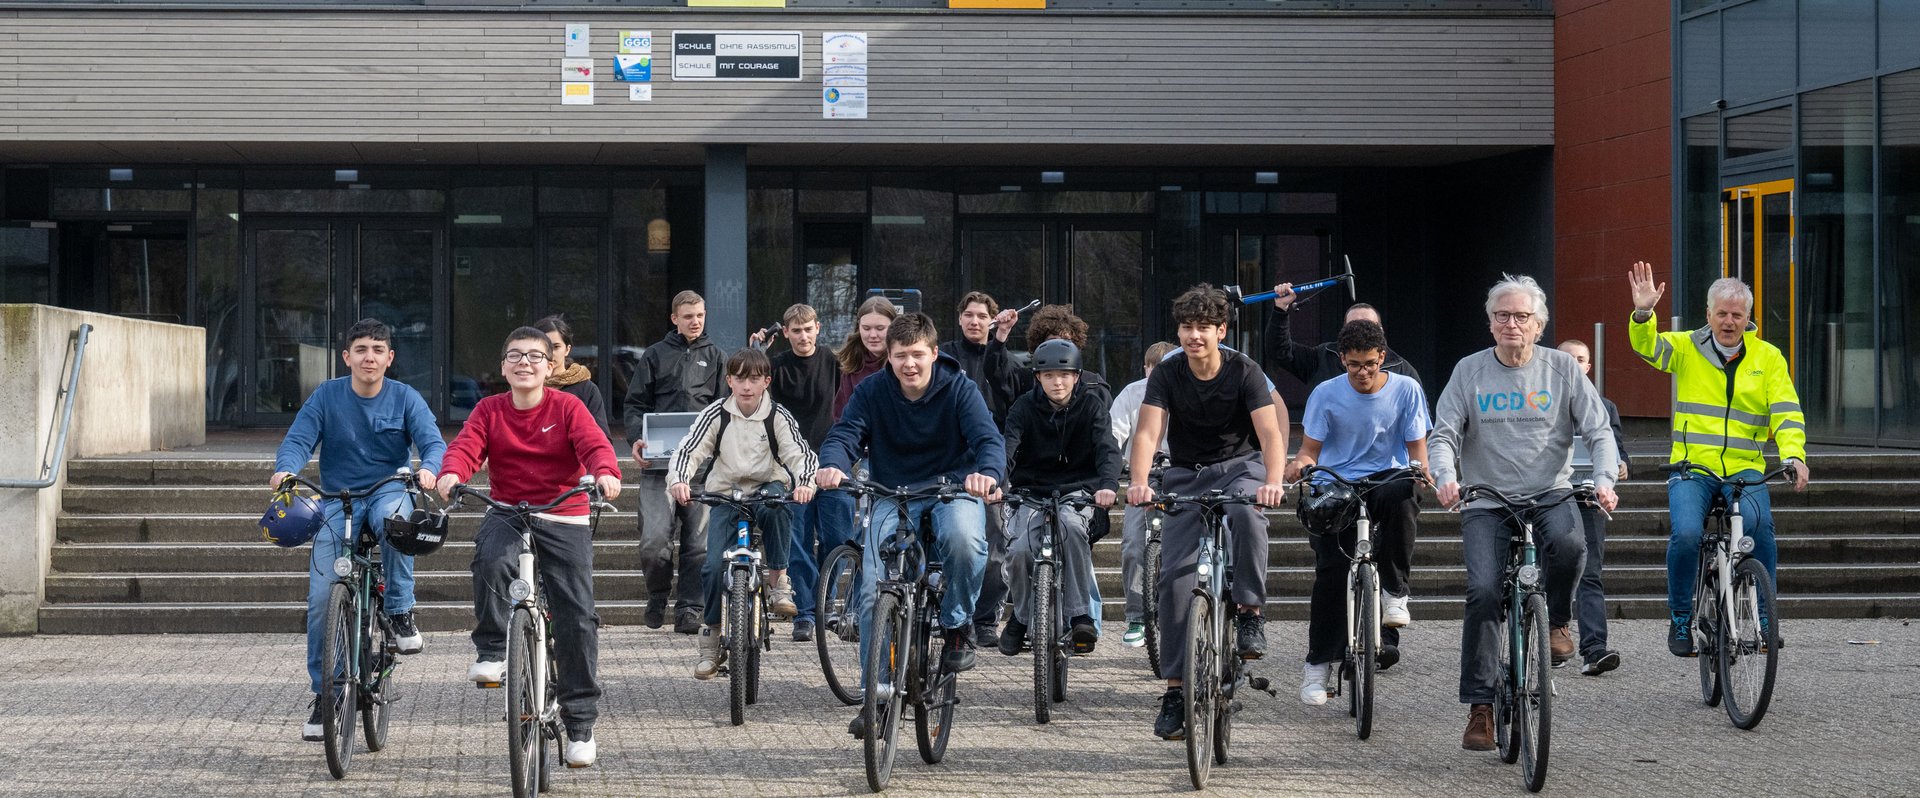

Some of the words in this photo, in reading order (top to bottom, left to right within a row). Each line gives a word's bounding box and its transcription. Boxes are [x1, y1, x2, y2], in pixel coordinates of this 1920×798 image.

[625, 38, 650, 46] GGG
[738, 62, 779, 70] COURAGE
[1477, 391, 1525, 412] VCD
